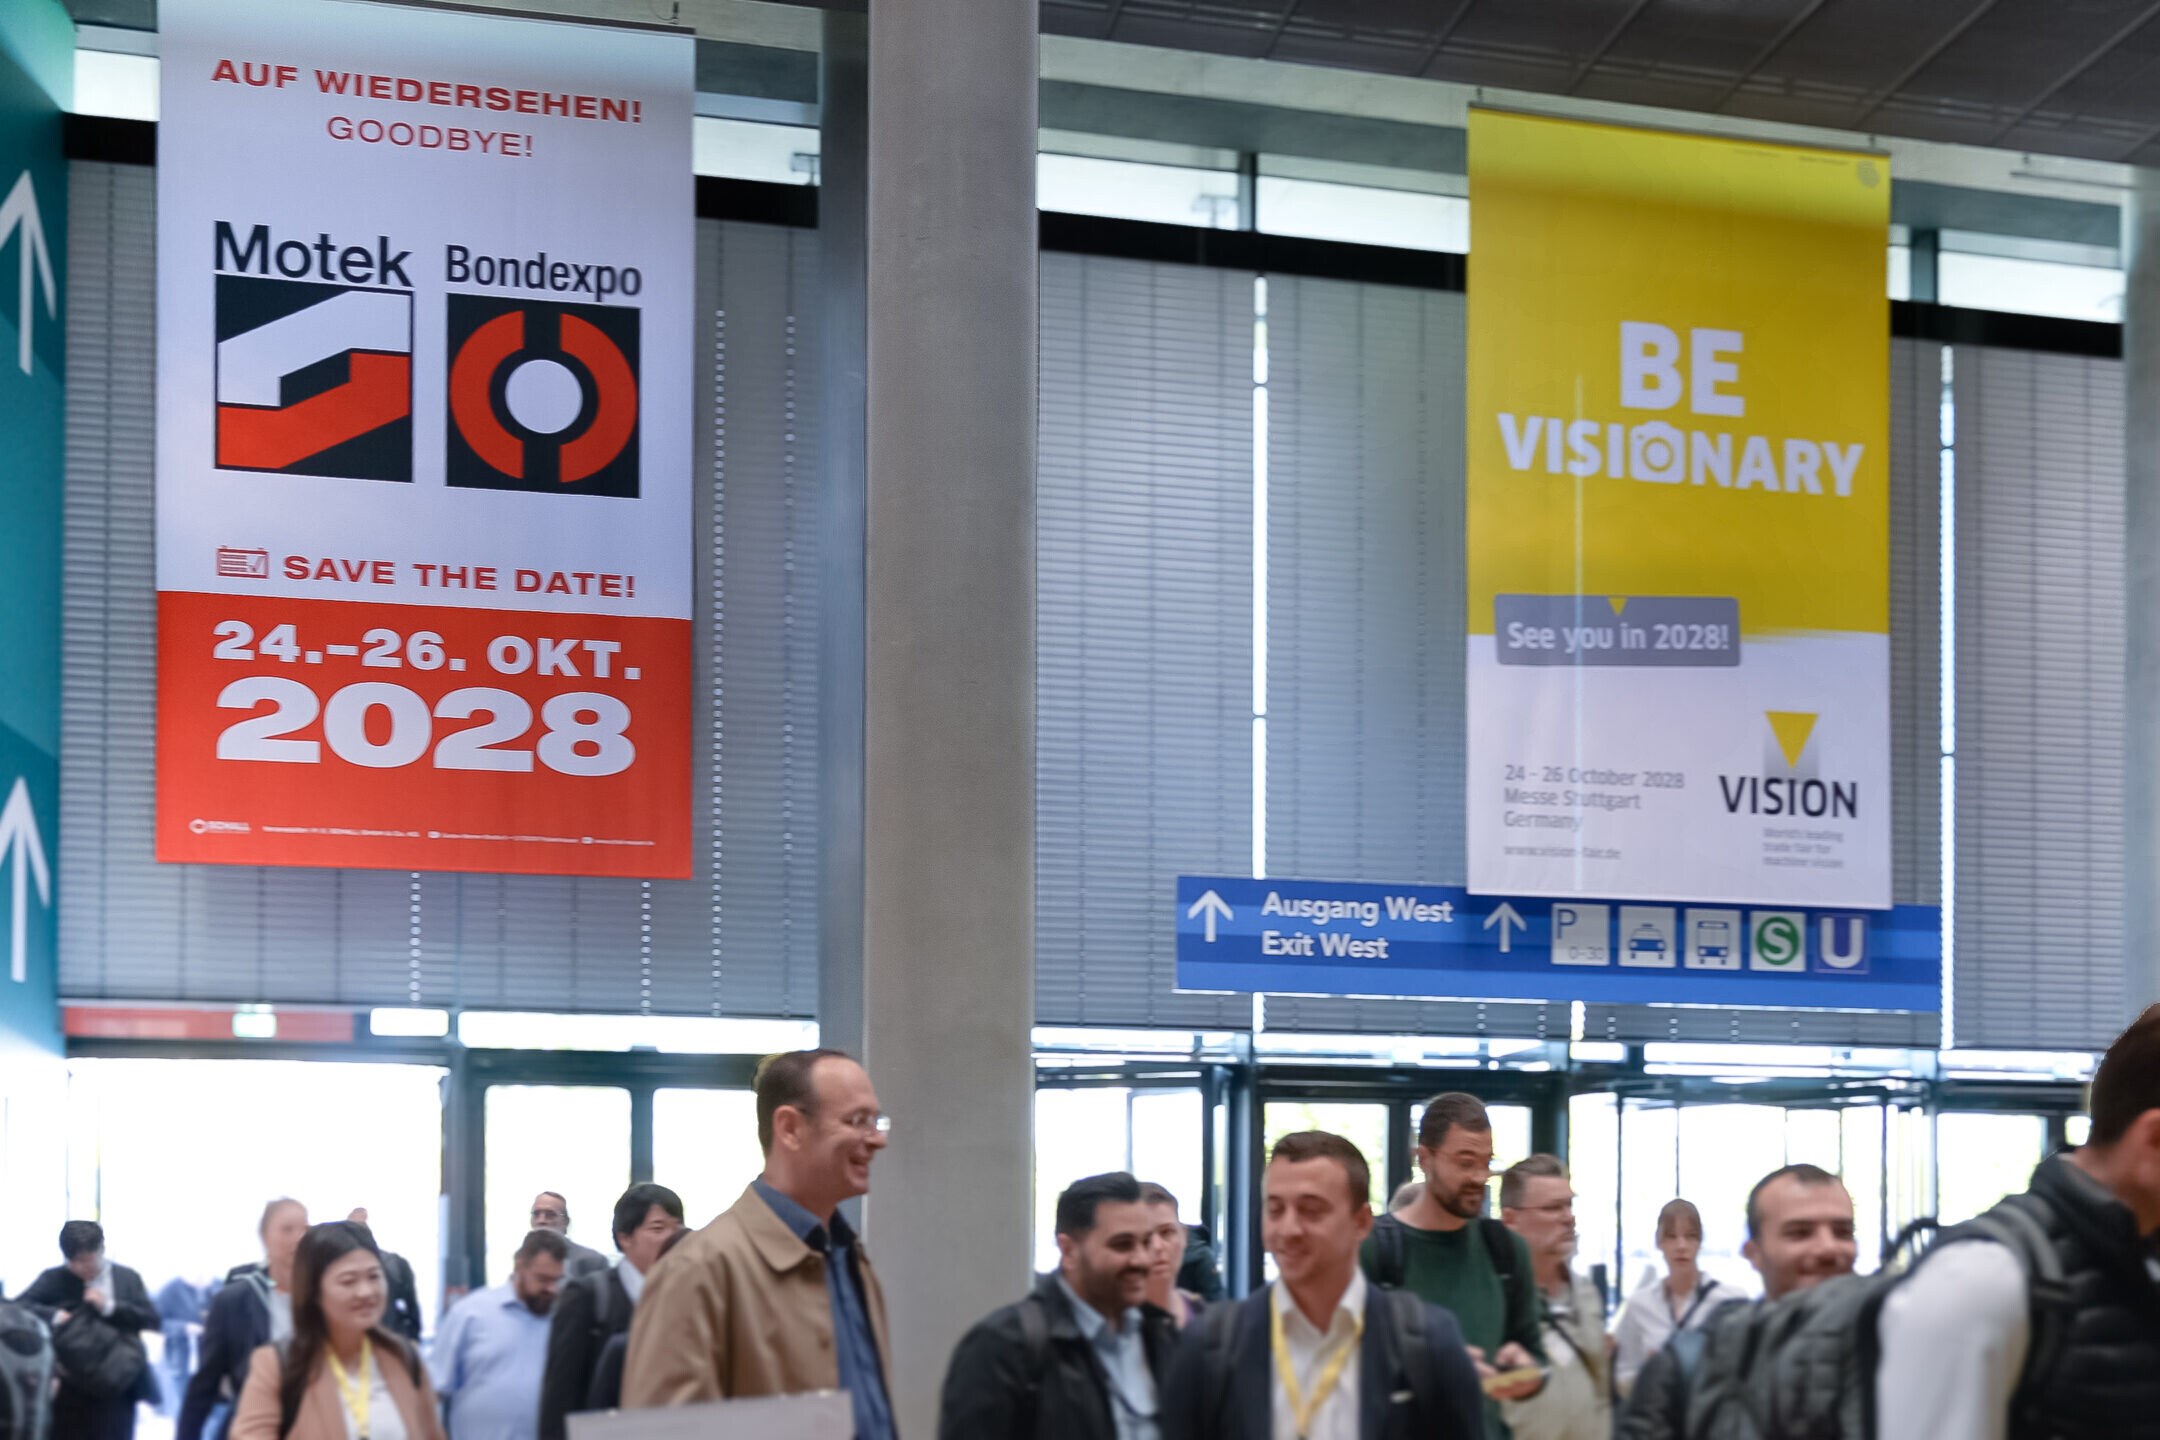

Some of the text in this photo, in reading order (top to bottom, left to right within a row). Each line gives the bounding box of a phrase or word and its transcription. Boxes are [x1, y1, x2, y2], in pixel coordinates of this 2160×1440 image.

[212, 58, 643, 124] AUF WIEDERSEHEN!
[327, 116, 533, 157] GOODBYE!
[214, 220, 413, 288] Motek
[445, 244, 642, 301] Bondexpo
[1620, 320, 1745, 417] BE
[283, 555, 636, 598] SAVE THE DATE!
[487, 635, 642, 680] OKT.
[1507, 621, 1729, 654] See you in 2028!
[216, 676, 635, 777] 2028
[1504, 764, 1525, 781] 24
[1542, 766, 1563, 782] 26
[1568, 768, 1637, 786] October
[1642, 771, 1685, 788] 2028
[1718, 775, 1857, 818] VISION
[1504, 788, 1641, 811] Messe Stuttgart
[1504, 810, 1582, 832] Germany
[1261, 891, 1454, 927] Ausgang West
[1557, 909, 1577, 940] P
[1262, 930, 1389, 959] Exit West
[1762, 921, 1793, 962] S
[1822, 917, 1864, 969] U
